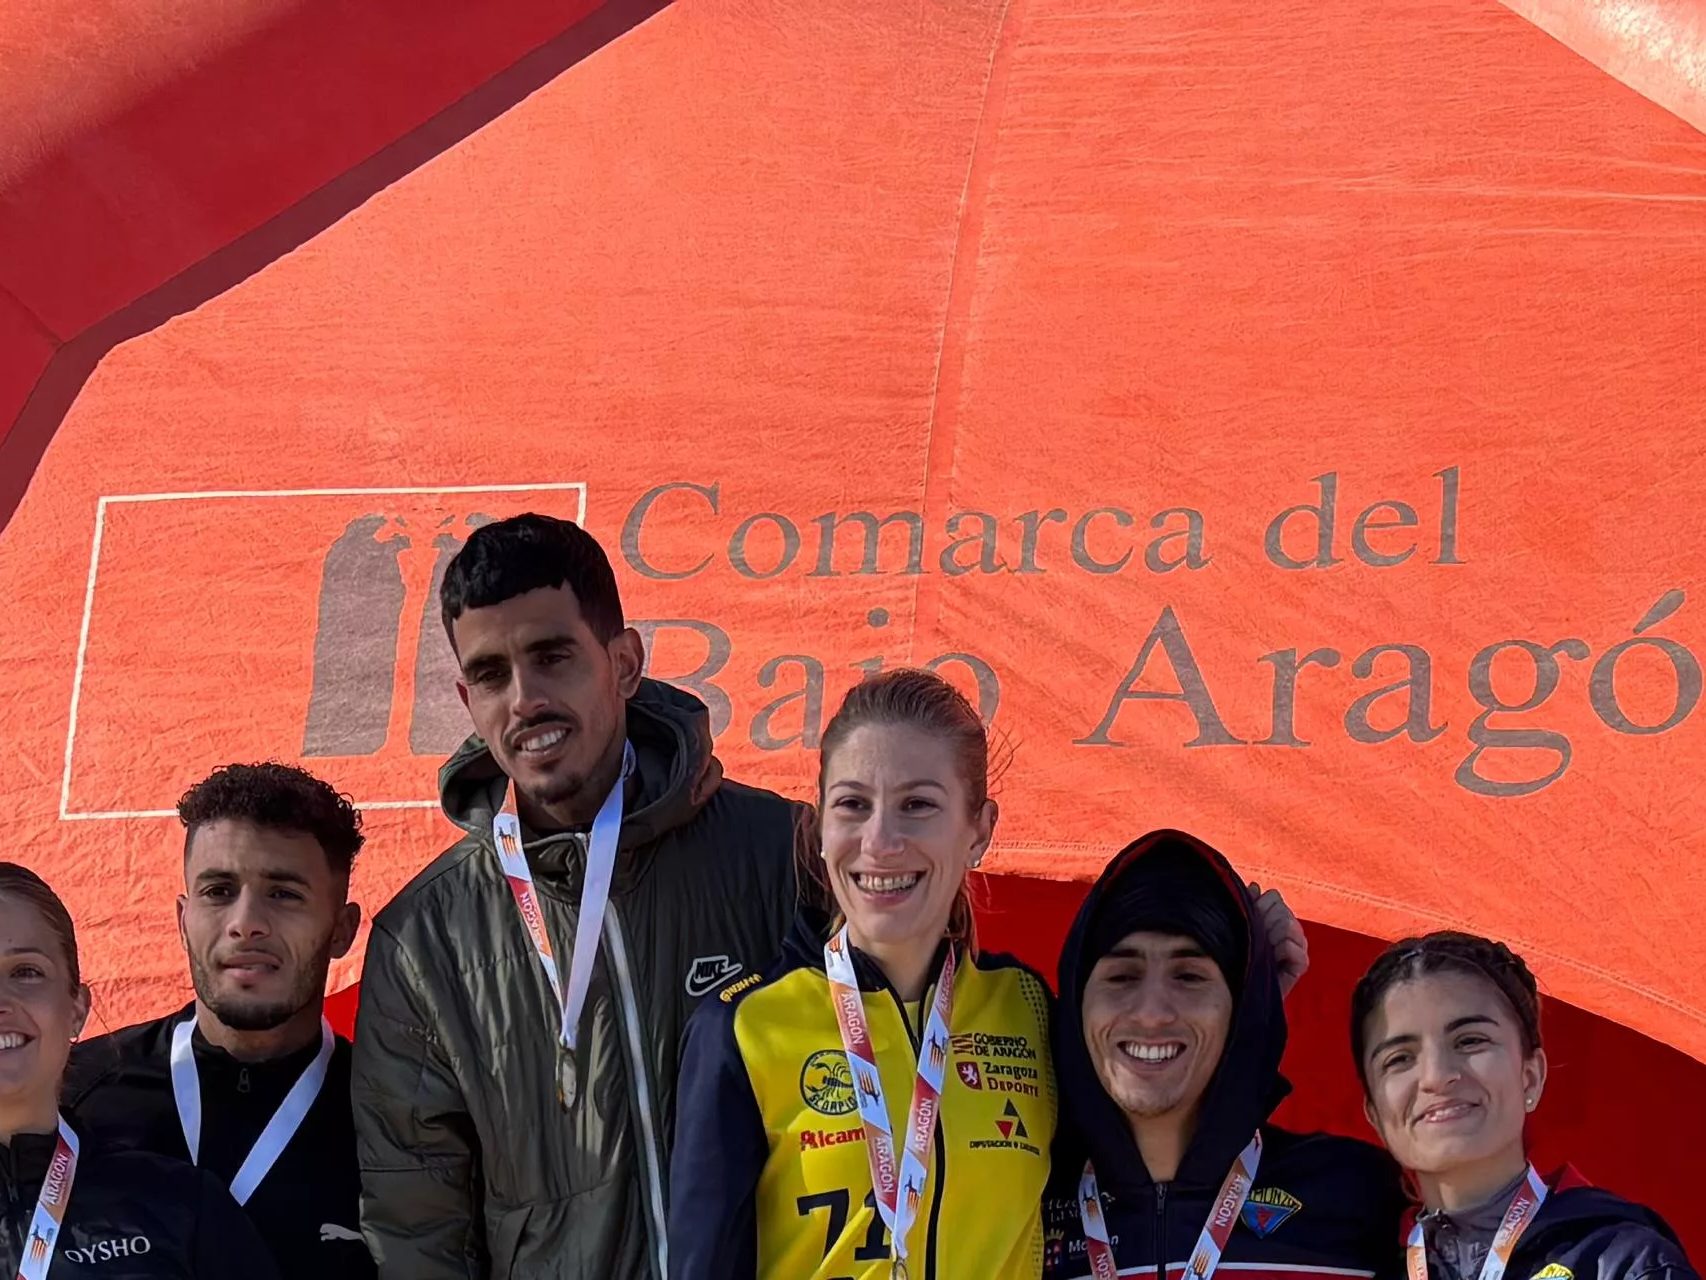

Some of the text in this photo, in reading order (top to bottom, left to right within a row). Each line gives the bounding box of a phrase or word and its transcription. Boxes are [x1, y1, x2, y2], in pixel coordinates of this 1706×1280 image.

[620, 465, 1468, 580] Comarca del
[695, 959, 729, 980] NIKE
[983, 1061, 1037, 1081] Zaragoza
[65, 1235, 152, 1265] OYSHO
